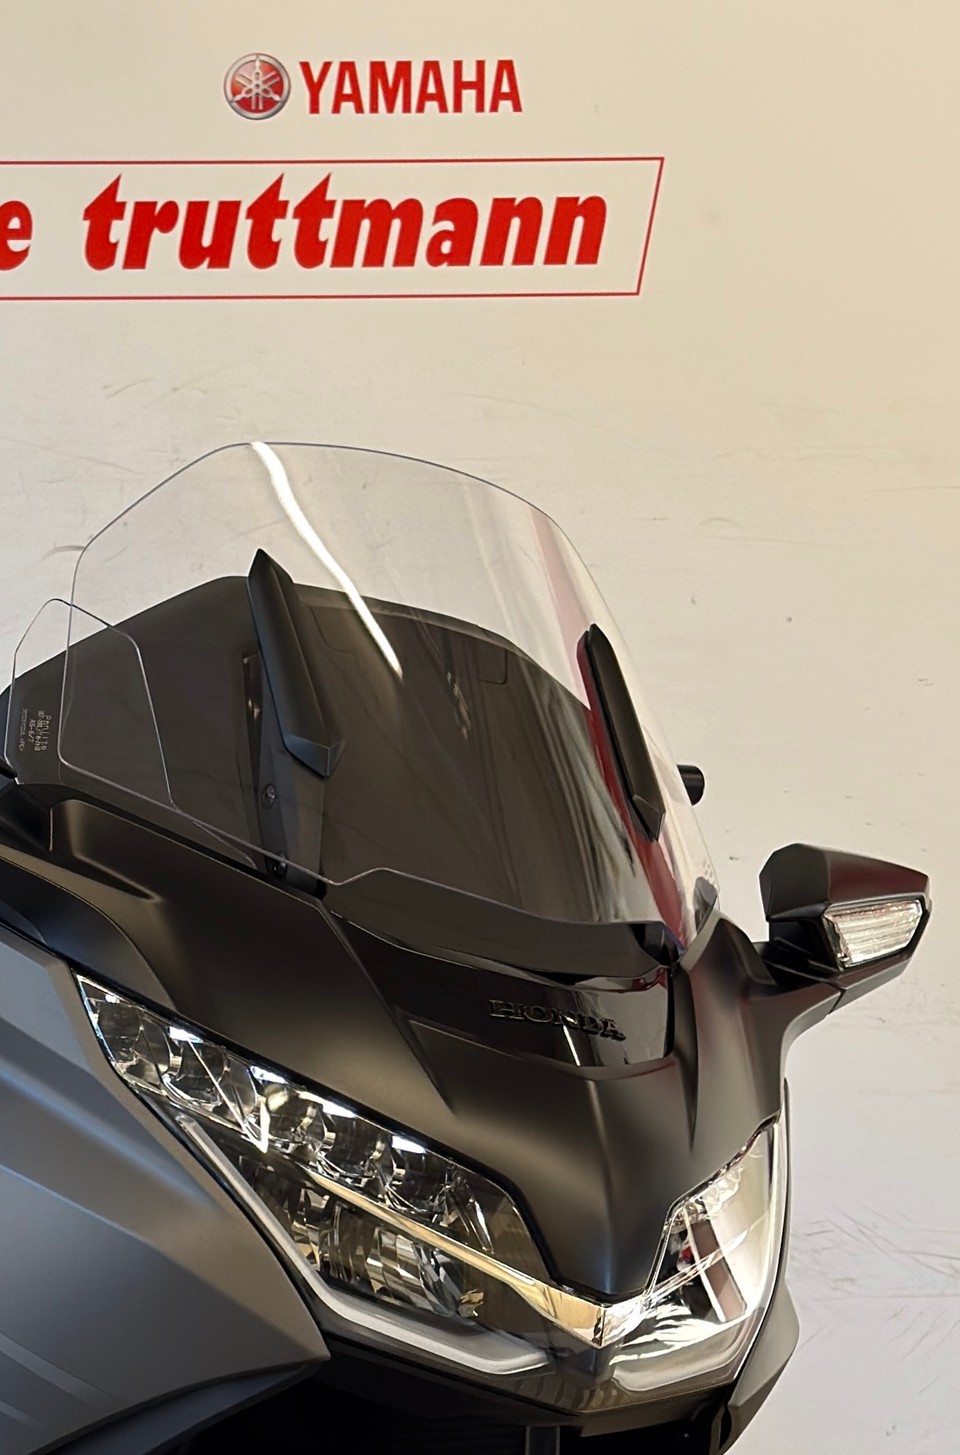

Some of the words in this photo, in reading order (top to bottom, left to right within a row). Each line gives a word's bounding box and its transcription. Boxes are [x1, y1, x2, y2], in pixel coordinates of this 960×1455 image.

[299, 58, 523, 115] YAMAHA
[82, 173, 608, 271] truttmann
[489, 999, 627, 1042] HONDA
